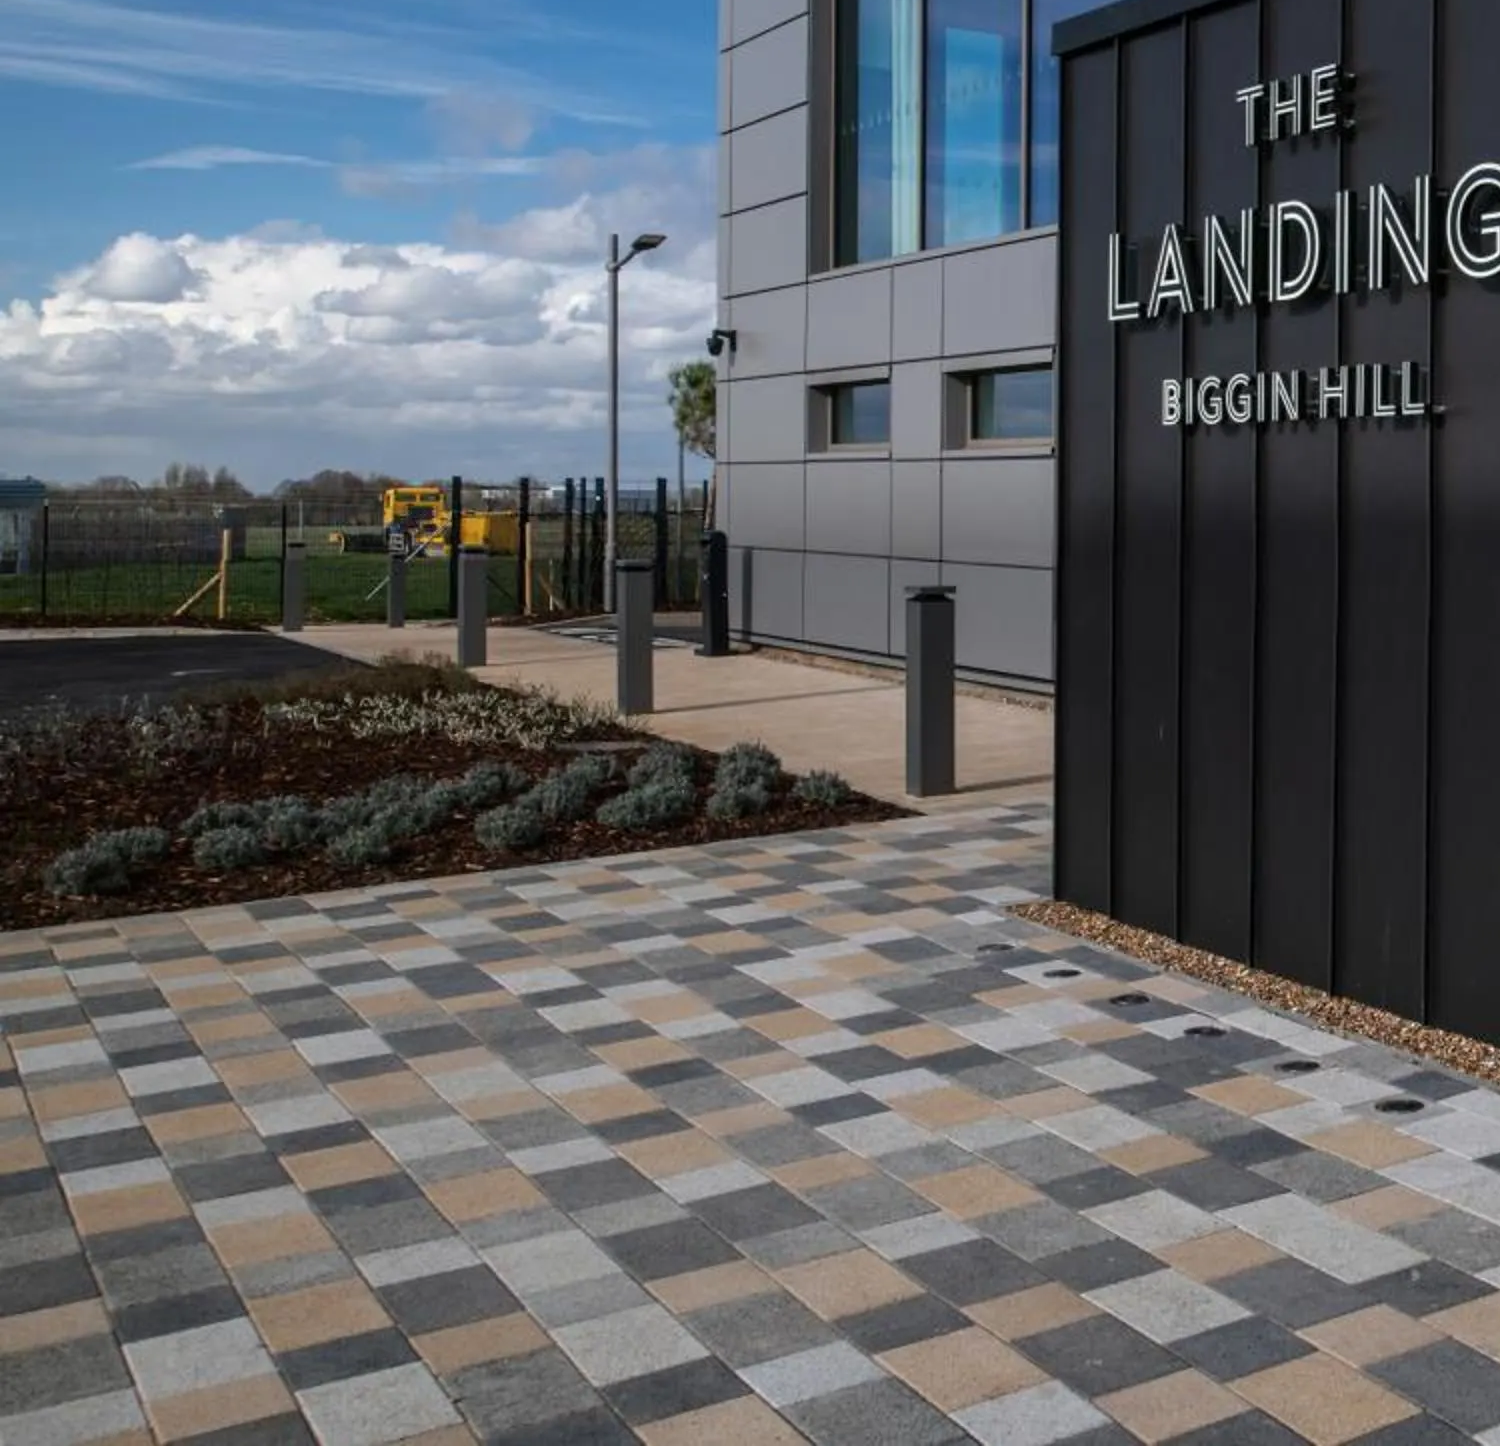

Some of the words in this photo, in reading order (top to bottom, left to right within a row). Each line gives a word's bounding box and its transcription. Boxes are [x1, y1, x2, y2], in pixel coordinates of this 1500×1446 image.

[1236, 63, 1338, 146] THE
[1161, 369, 1300, 427] BIGGIN
[1318, 361, 1426, 420] HILL
